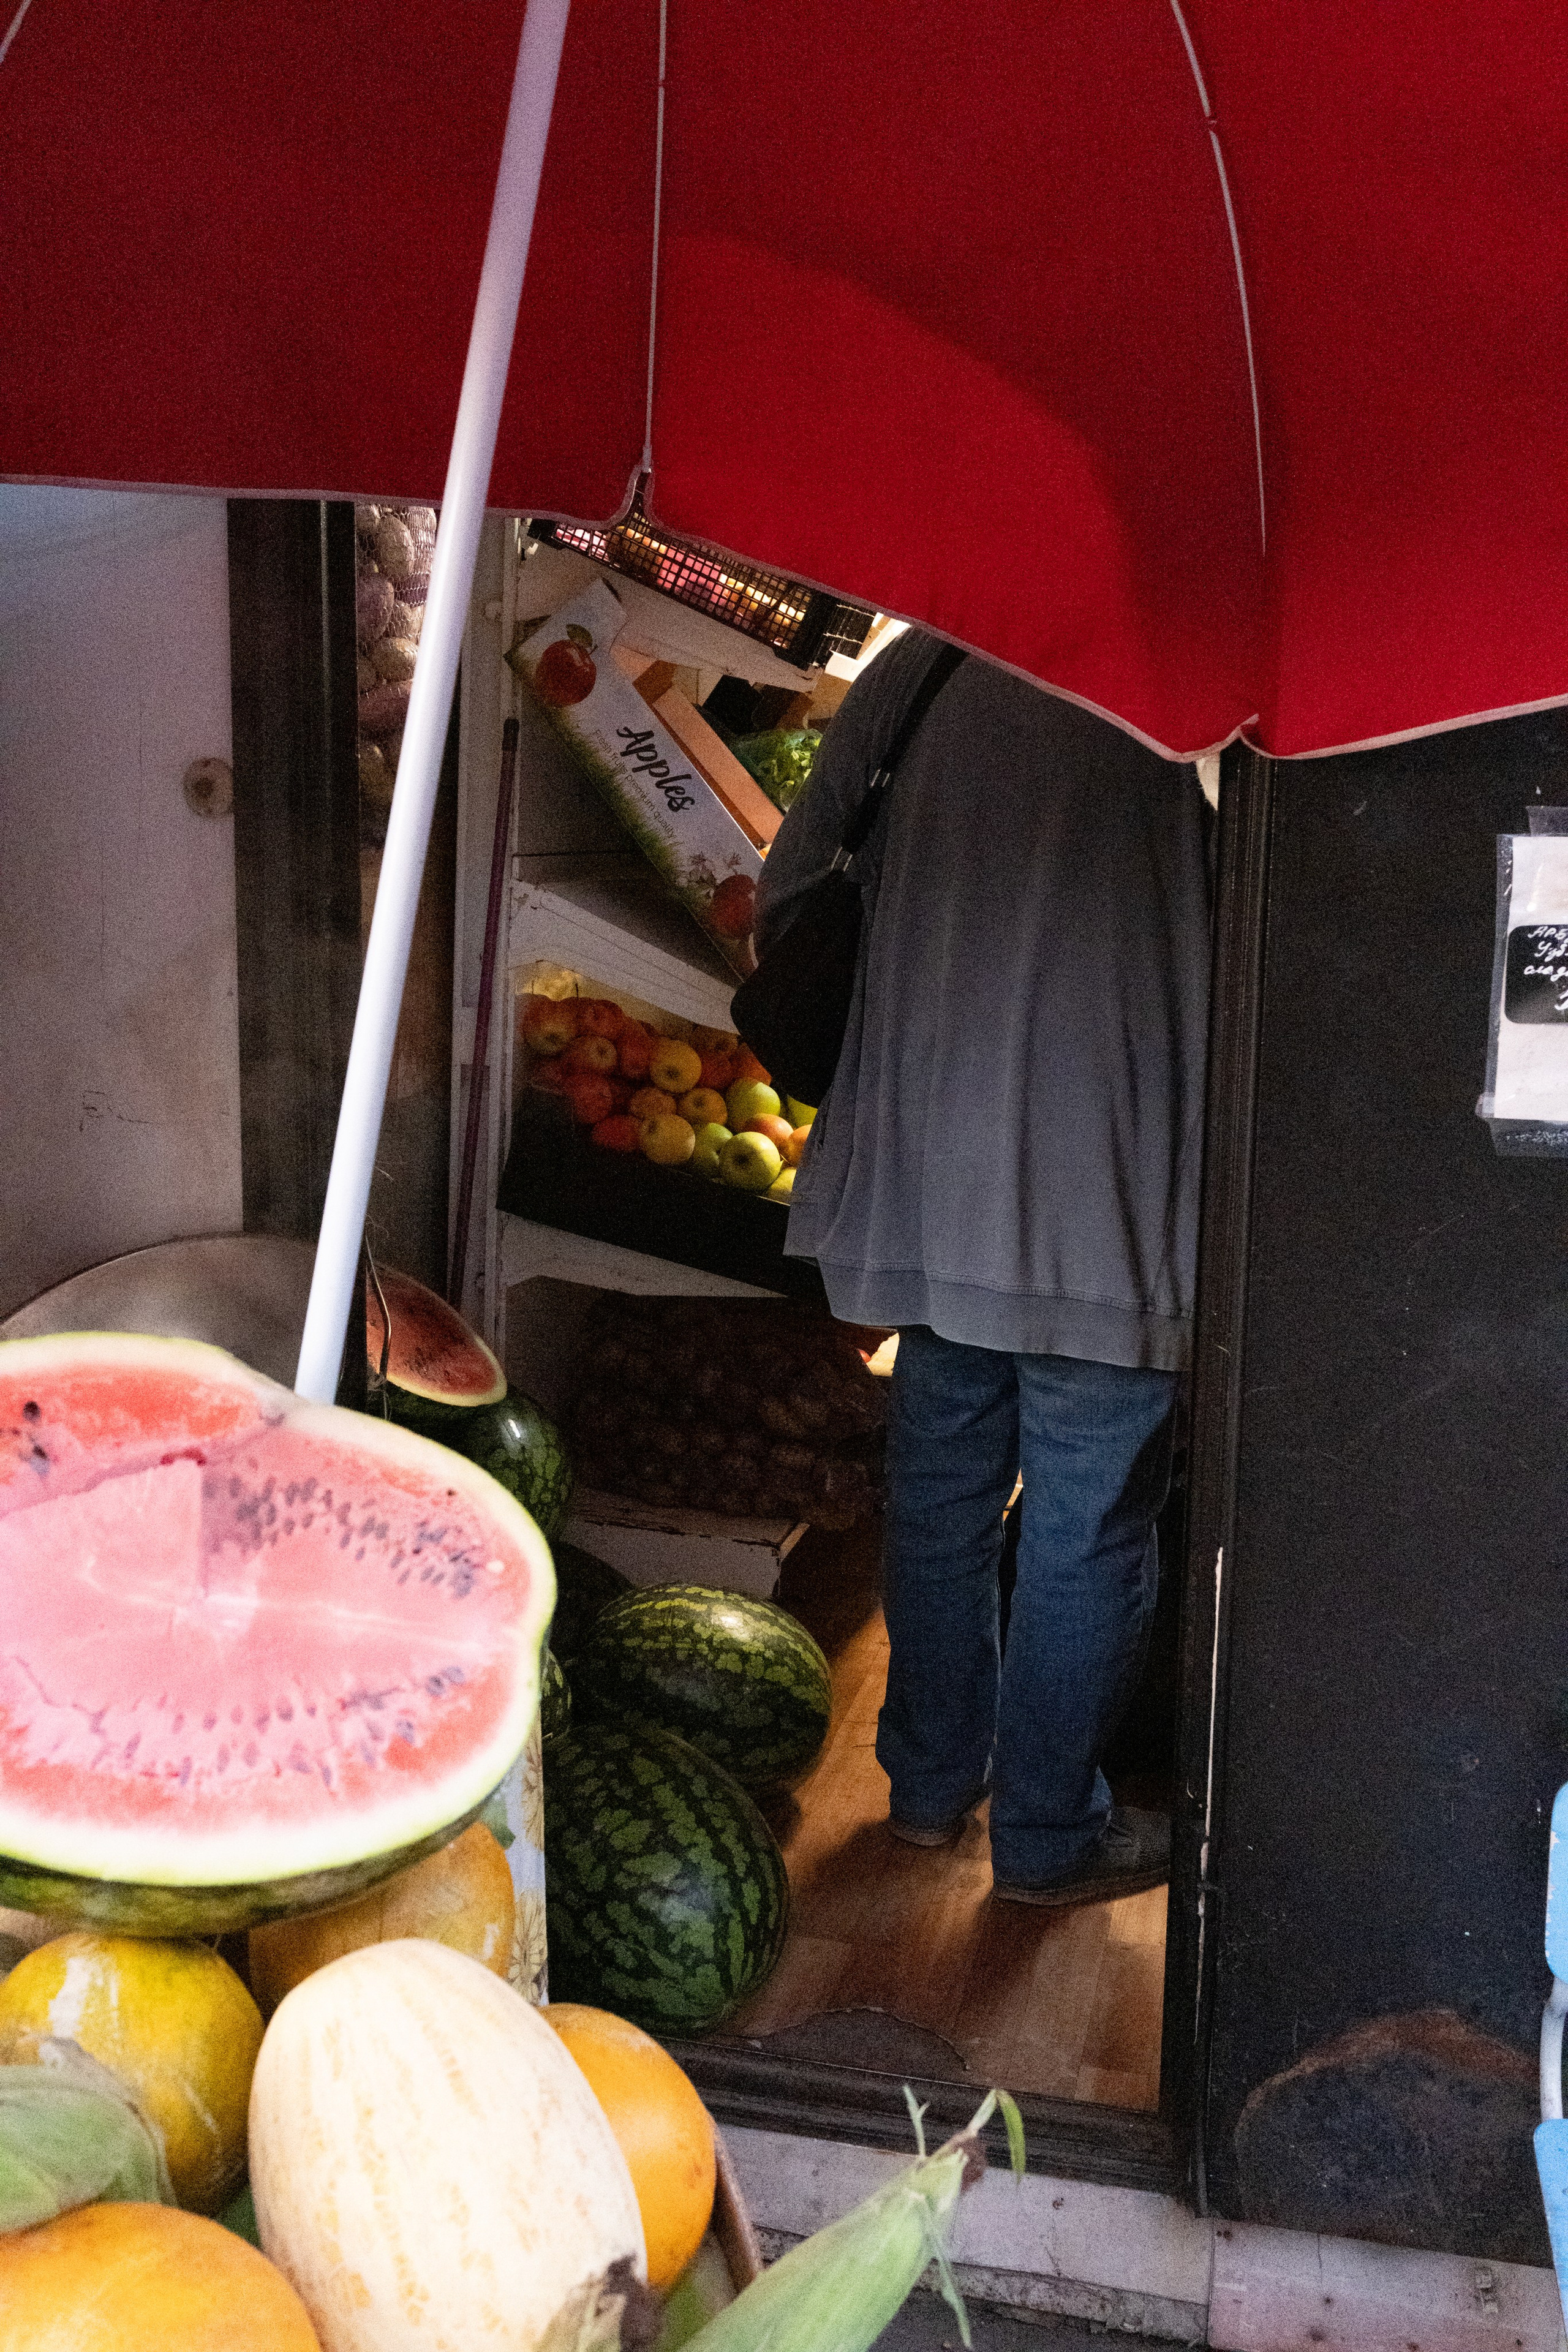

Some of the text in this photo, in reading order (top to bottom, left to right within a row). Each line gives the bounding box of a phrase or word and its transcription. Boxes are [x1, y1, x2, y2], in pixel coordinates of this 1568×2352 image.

[595, 729, 675, 839] Fresh fruits premium quality
[616, 726, 695, 812] Apples
[1528, 926, 1568, 943] АРБ
